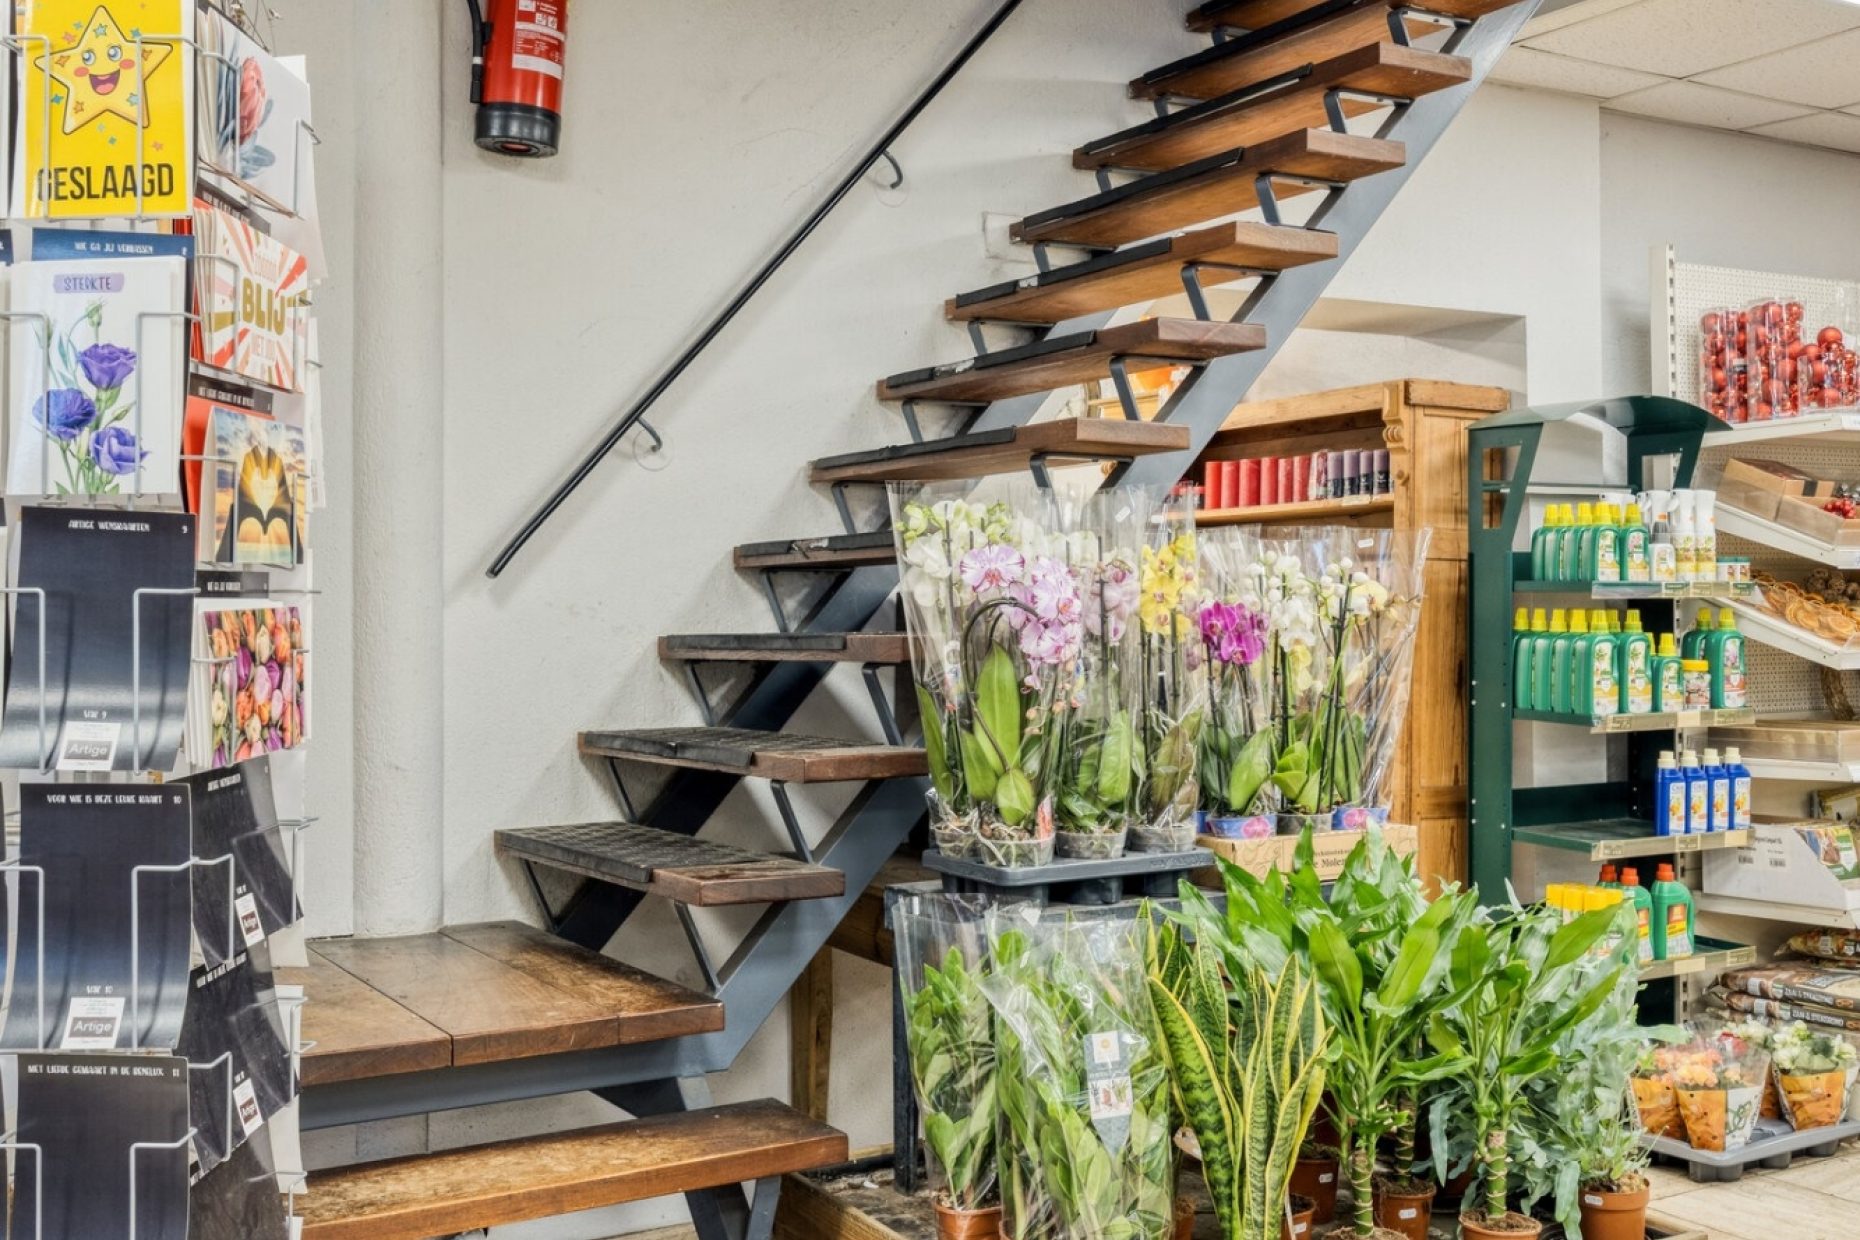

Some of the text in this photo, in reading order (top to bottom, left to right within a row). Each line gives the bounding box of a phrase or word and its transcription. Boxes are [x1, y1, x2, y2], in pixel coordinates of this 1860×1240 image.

[37, 163, 173, 201] GESLAAGD
[64, 277, 111, 291] STERKTE
[242, 277, 285, 336] BLIJ
[68, 520, 94, 529] ARTIGE
[69, 743, 108, 757] Artige
[47, 795, 181, 804] VOOR WIE IS DEZE LEUKE KAART 10
[74, 1020, 113, 1035] Artige
[28, 1064, 43, 1073] MET
[72, 1065, 106, 1075] GEMAAKT
[120, 1066, 130, 1075] DE
